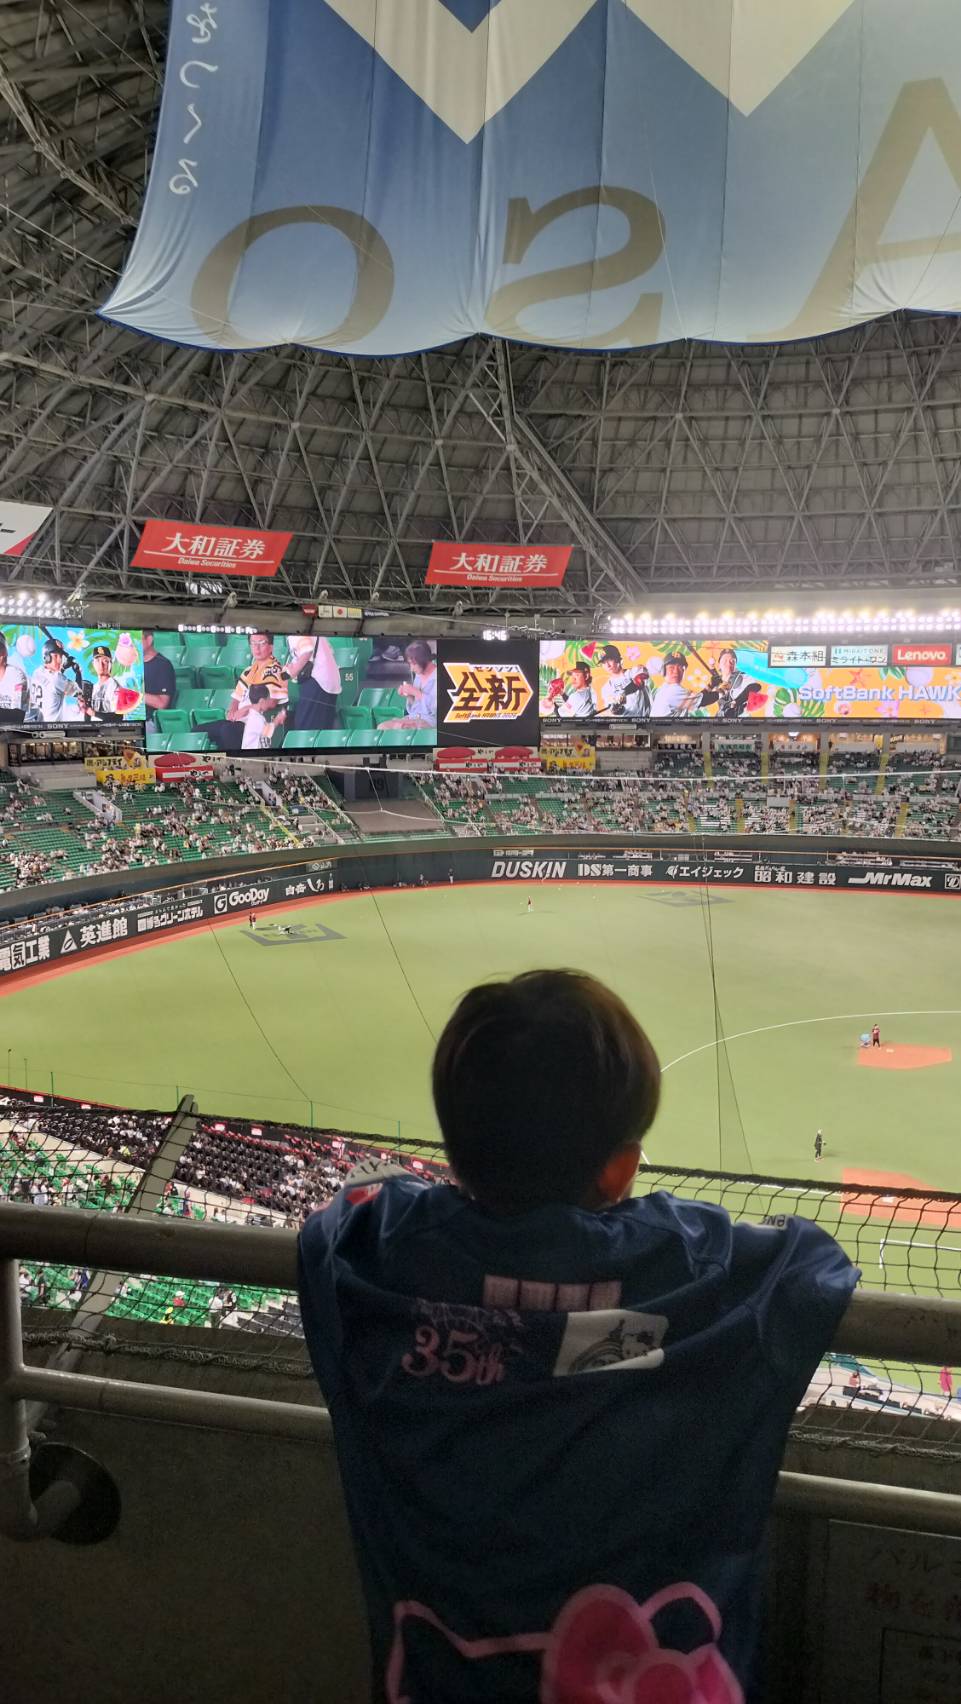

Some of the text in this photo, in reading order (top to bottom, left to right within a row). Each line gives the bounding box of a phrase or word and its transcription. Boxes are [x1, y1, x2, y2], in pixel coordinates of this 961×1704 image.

[161, 533, 266, 560] 大和証券
[178, 557, 236, 568] Daiwa Securities
[450, 552, 548, 573] 大和証券
[483, 630, 507, 641] 16:46
[897, 649, 947, 661] Lenovo
[451, 671, 528, 711] 全新
[799, 685, 896, 700] SoftBank
[491, 861, 566, 878] DUSKIN
[679, 866, 744, 878] エイジェック
[754, 870, 836, 886] 昭和建設
[864, 872, 933, 887] MrMax
[229, 887, 270, 907] GooDay
[80, 917, 128, 948] 英進館
[401, 1325, 505, 1386] 35th
